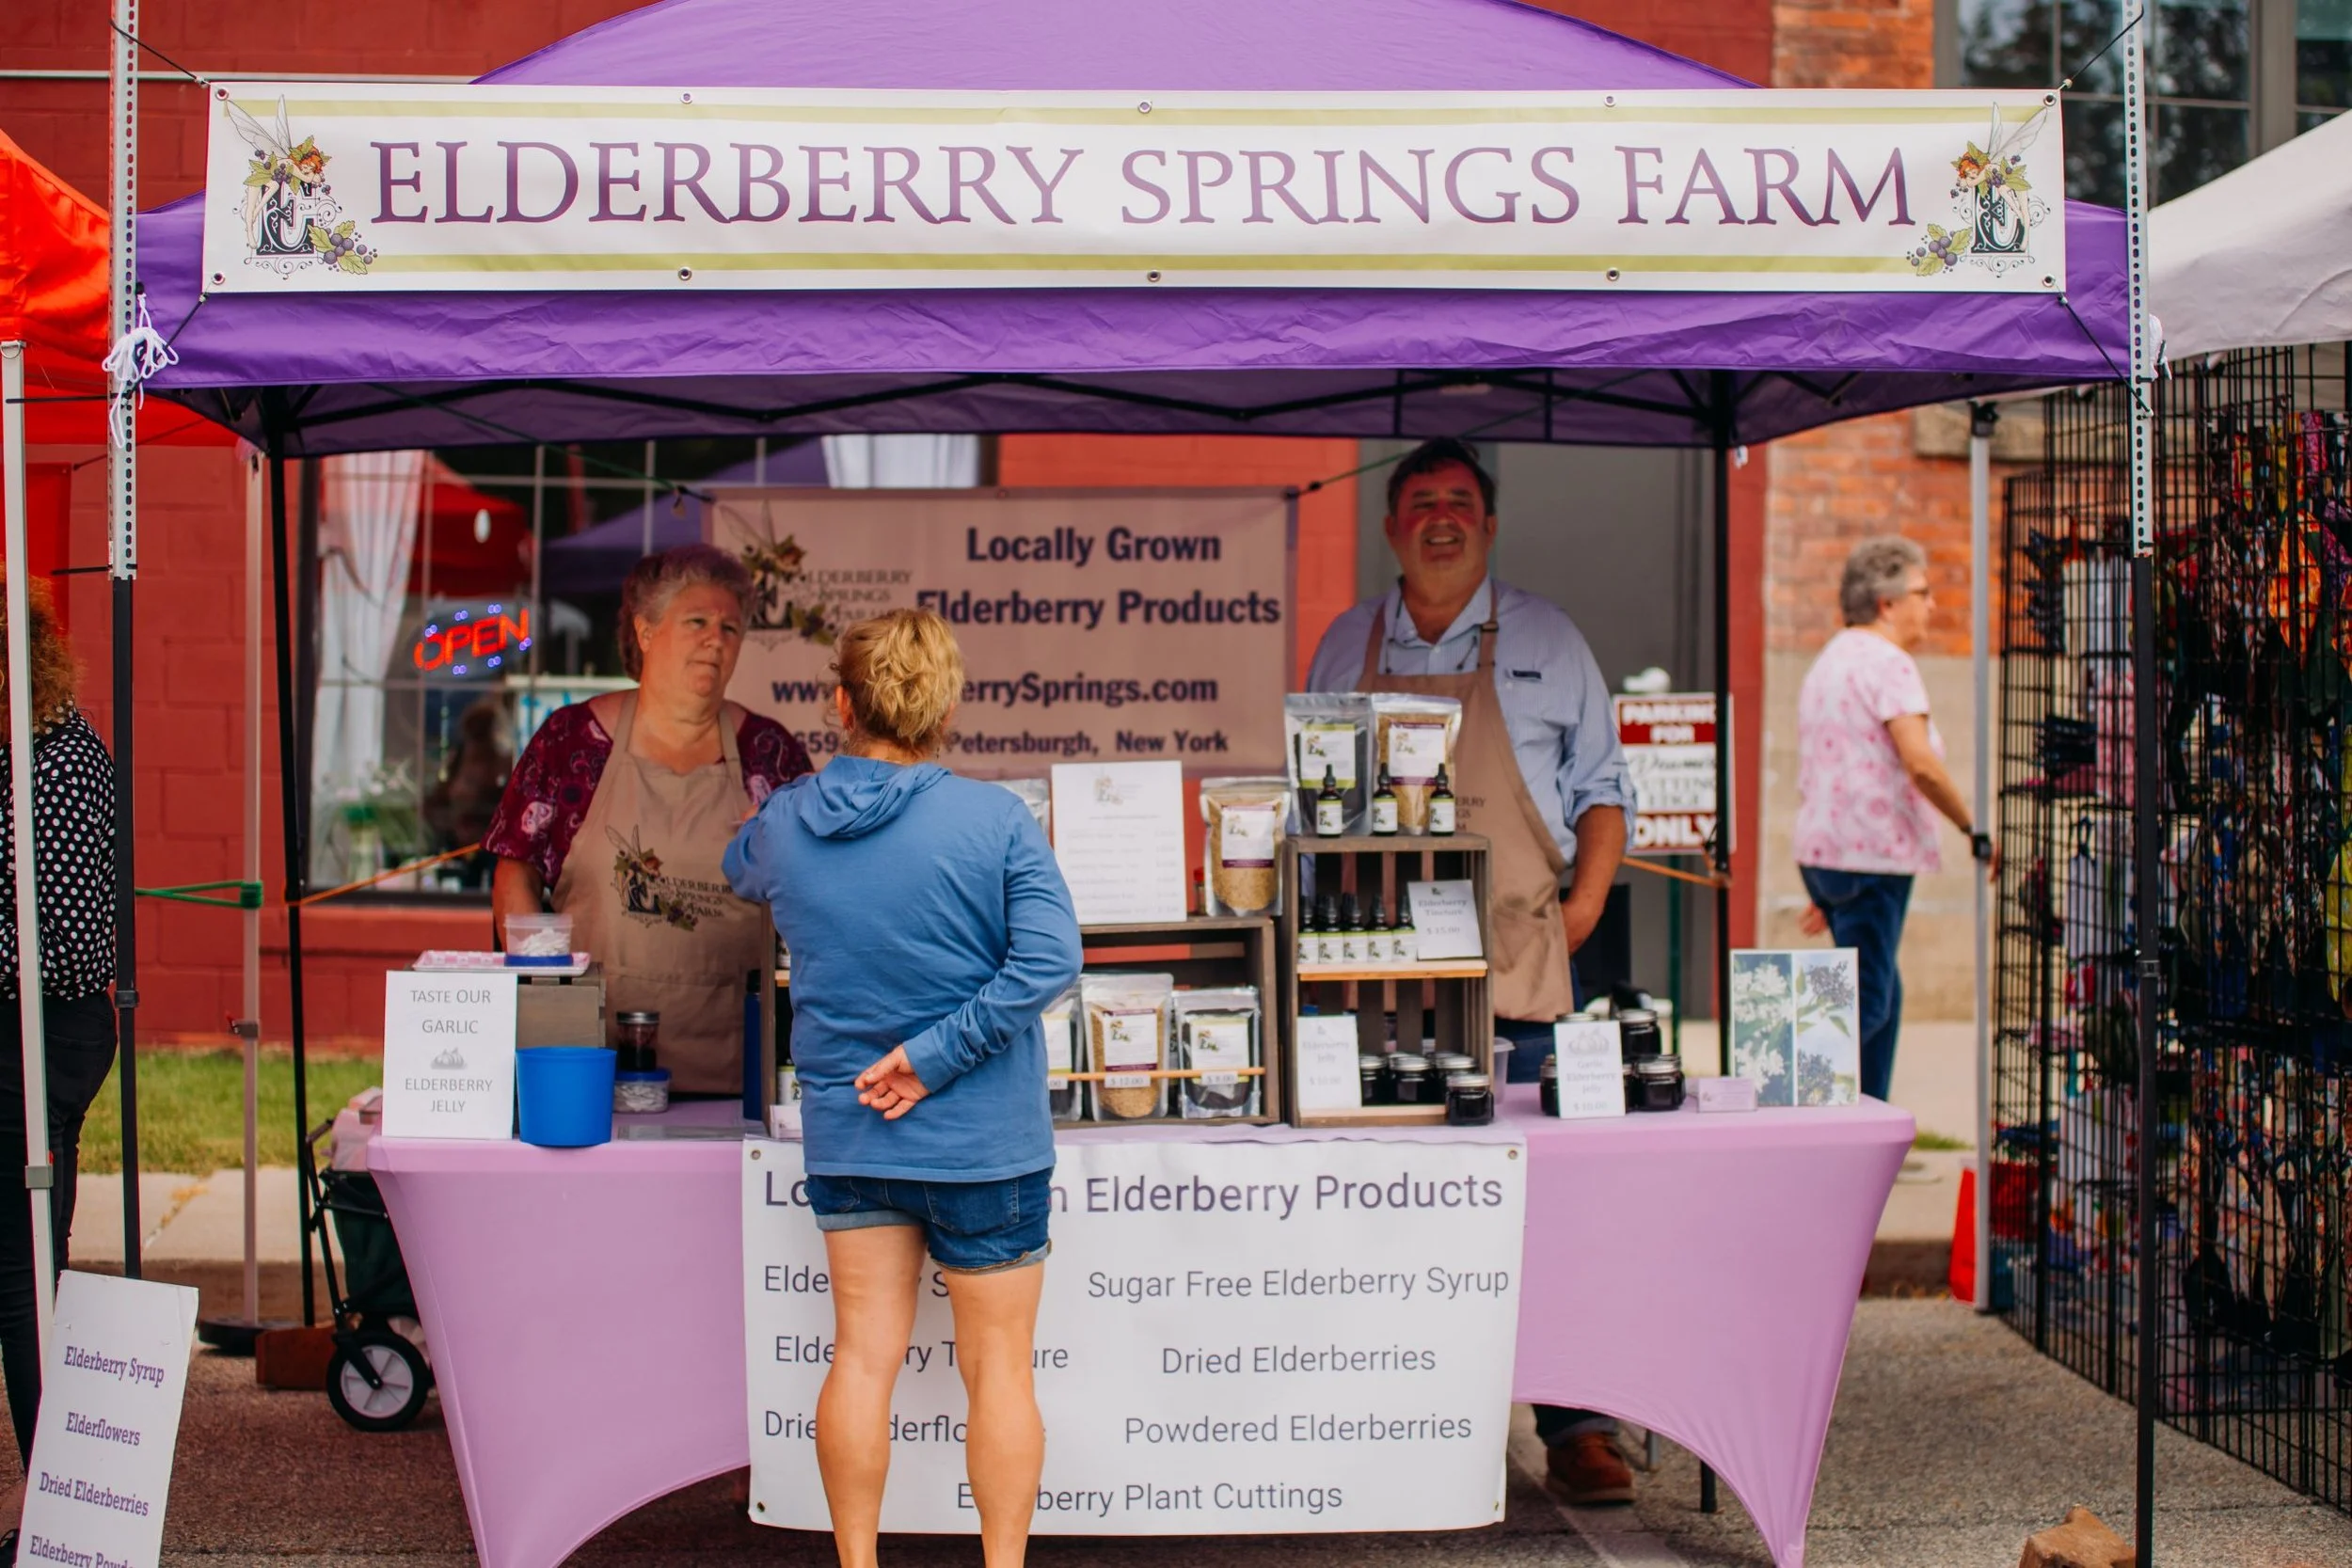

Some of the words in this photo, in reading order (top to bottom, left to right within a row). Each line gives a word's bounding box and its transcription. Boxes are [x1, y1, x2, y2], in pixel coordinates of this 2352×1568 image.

[370, 140, 1084, 226] ELDERBERRY
[1121, 145, 1581, 227] SPRINGS
[1614, 145, 1915, 227] FARM
[966, 527, 1095, 566] Locally
[1106, 527, 1221, 562] Grown
[917, 589, 1105, 631] Elderberry
[1118, 589, 1281, 626] Products
[414, 608, 530, 671] OPEN
[1116, 731, 1165, 752] New
[1174, 730, 1229, 753] York
[1633, 816, 1716, 847] ONLY
[411, 990, 452, 1004] TASTE
[455, 989, 491, 1005] OUR
[421, 1020, 479, 1035] GARLIC
[405, 1078, 493, 1092] ELDERBERRY
[430, 1100, 467, 1113] JELLY
[1085, 1177, 1300, 1220] Elderberry
[1315, 1171, 1503, 1211] Products
[1088, 1272, 1175, 1304] Sugar
[1186, 1270, 1252, 1296] Free
[1263, 1268, 1416, 1300] Elderberry
[1426, 1266, 1509, 1299] Syrup
[64, 1345, 127, 1381] Elderberry
[129, 1357, 165, 1388] Syrup
[1163, 1347, 1241, 1374] Dried
[1253, 1345, 1437, 1373] Elderberries
[65, 1411, 141, 1447] Elderflowers
[765, 1410, 817, 1438] Drie
[1124, 1415, 1278, 1444] Powdered
[1290, 1413, 1472, 1442] Elderberries
[39, 1471, 72, 1498] Dried
[73, 1480, 150, 1517] Elderberries
[1125, 1483, 1203, 1511] Plant
[1213, 1481, 1343, 1515] Cuttings
[29, 1534, 92, 1568] Elderberry
